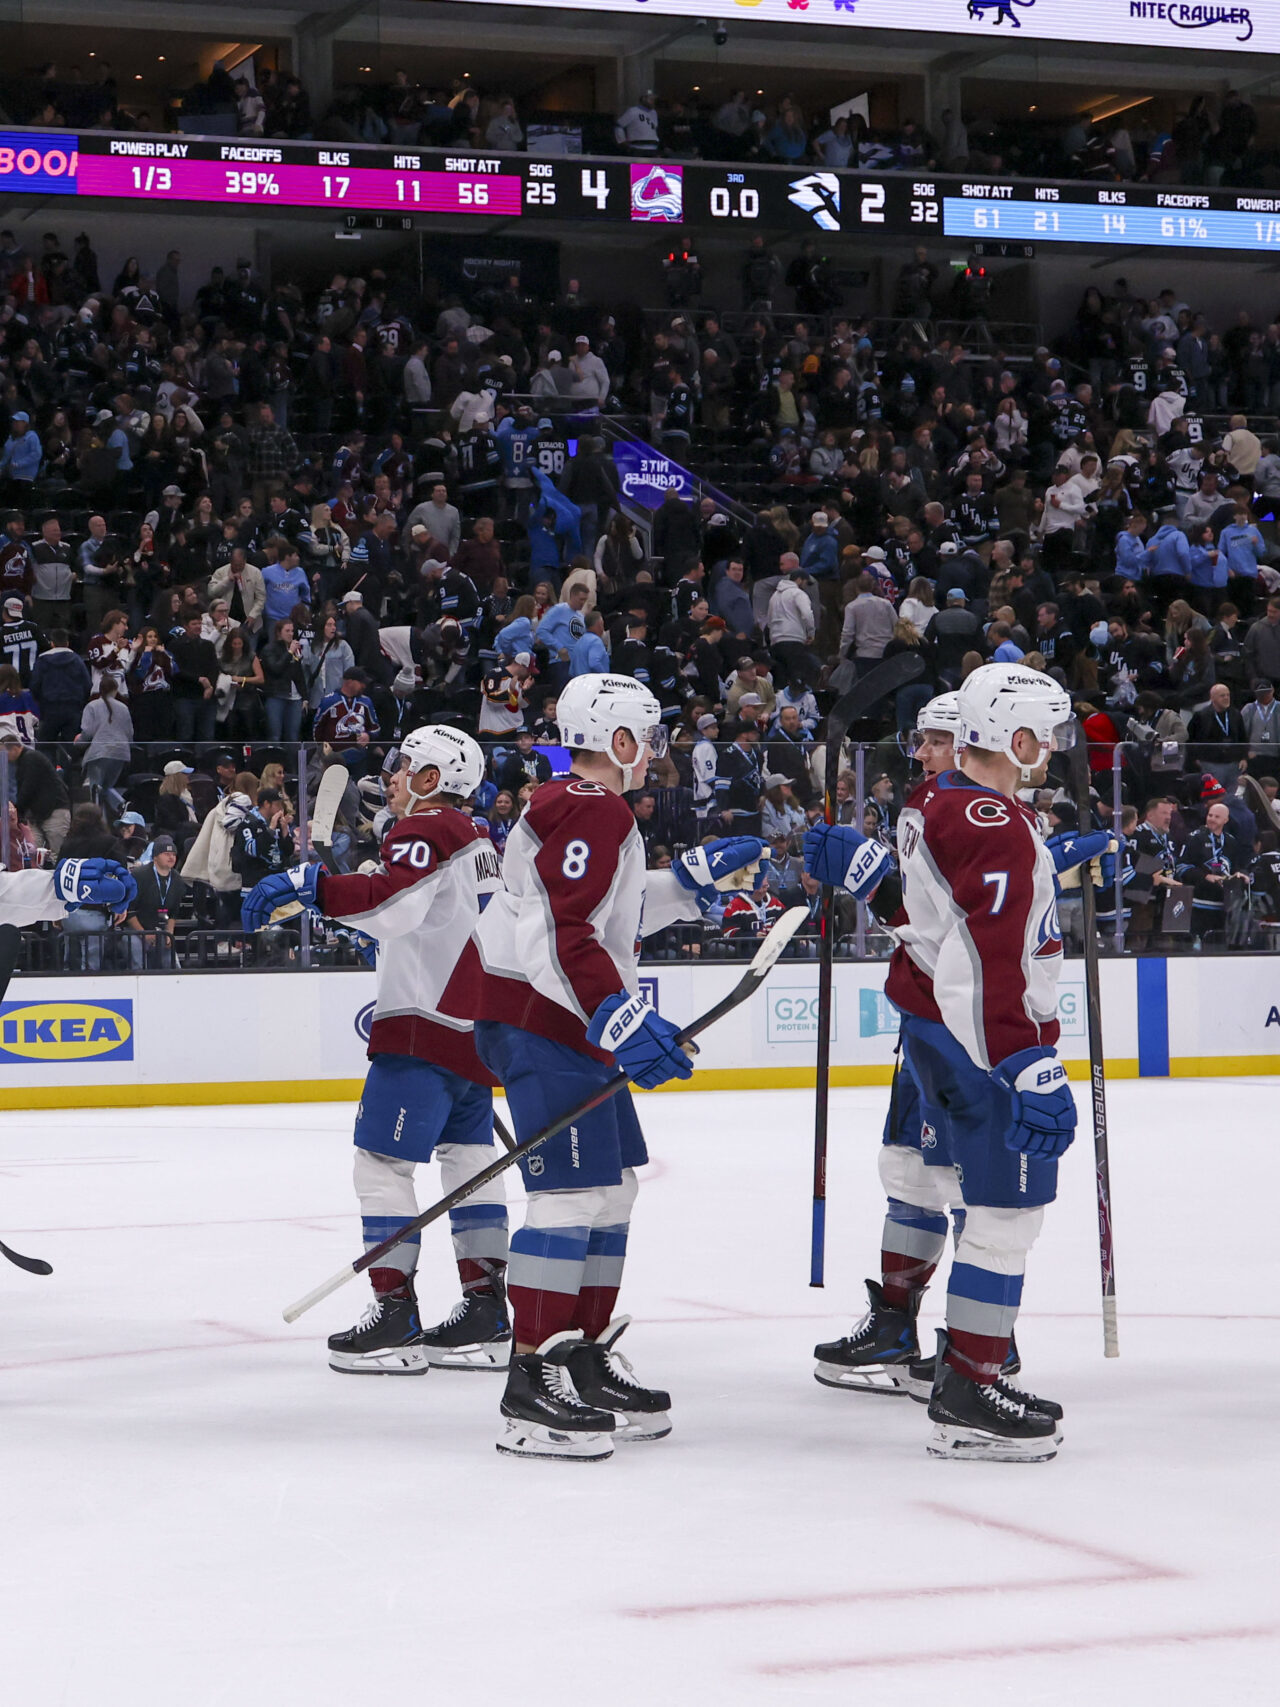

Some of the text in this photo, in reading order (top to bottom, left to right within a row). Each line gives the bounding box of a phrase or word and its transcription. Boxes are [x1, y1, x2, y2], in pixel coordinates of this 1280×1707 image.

[221, 146, 282, 163] FACEOFFS
[318, 152, 349, 166] BLKS
[394, 155, 420, 169] HITS
[445, 158, 501, 174] SHOT ATT
[529, 164, 553, 177] SOG
[132, 166, 172, 191] 1/3
[226, 171, 279, 195] 39%
[322, 176, 350, 199] 17
[581, 169, 610, 209] 4
[727, 174, 744, 183] 3RD
[396, 180, 420, 202] 11
[458, 183, 489, 205] 56
[526, 183, 556, 205] 25
[913, 183, 935, 197] SOG
[962, 184, 1013, 198] SHOT ATT
[1035, 188, 1059, 201] HITS
[1098, 191, 1126, 205] BLKS
[710, 188, 759, 218] 0.0
[861, 184, 885, 223] 2
[1157, 194, 1210, 208] FACEOFFS
[1237, 198, 1273, 211] POWER
[346, 216, 357, 228] 17
[910, 201, 939, 223] 32
[973, 209, 1000, 229] 61
[1034, 211, 1059, 232] 21
[1101, 214, 1126, 235] 14
[1161, 217, 1207, 239] 61%
[1132, 371, 1147, 393] 9
[1186, 424, 1202, 444] 9
[512, 442, 524, 463] 8
[538, 450, 565, 474] 98
[961, 503, 987, 532] UTAH
[4, 629, 33, 644] PETERKA
[4, 640, 39, 676] 77
[88, 649, 99, 661] 29
[487, 678, 495, 690] 8
[601, 678, 641, 692] Kiewit
[724, 679, 733, 692] 9
[433, 725, 466, 748] Kiewit
[705, 760, 713, 771] 9
[242, 828, 251, 841] 9
[390, 841, 431, 869] 70
[562, 839, 590, 880] 8
[982, 871, 1009, 915] 7
[2, 1018, 121, 1044] IKEA
[776, 1024, 810, 1032] PROTEIN
[1061, 1018, 1077, 1026] BAR
[1093, 1064, 1104, 1126] BAUER
[393, 1107, 407, 1142] CCM
[570, 1126, 580, 1168] BAUER
[1018, 1152, 1028, 1194] BAUER
[600, 1386, 629, 1401] BAUER
[534, 1398, 559, 1416] BAUER
